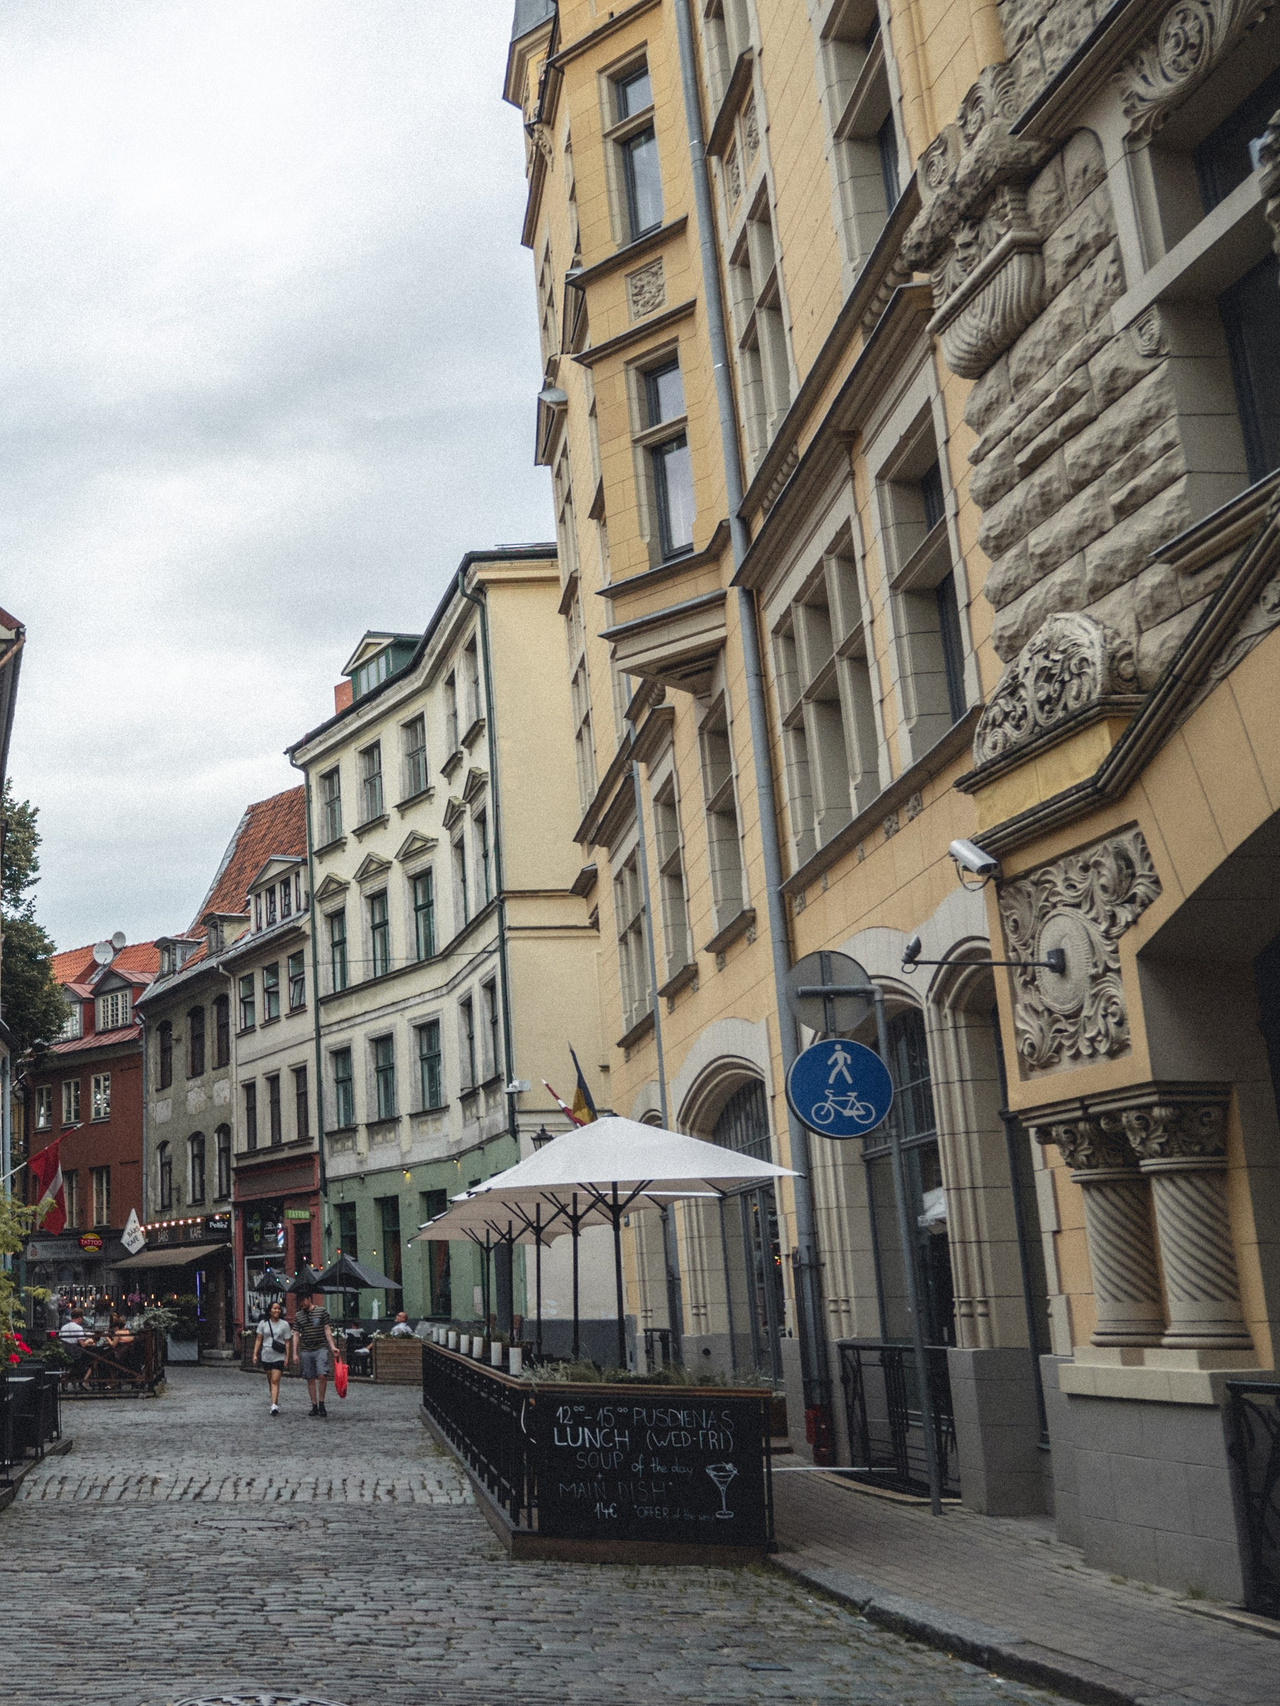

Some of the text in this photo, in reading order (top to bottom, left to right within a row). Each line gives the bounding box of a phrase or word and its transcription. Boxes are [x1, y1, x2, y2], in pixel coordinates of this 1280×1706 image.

[633, 1407, 734, 1431] PUSDIENAS
[554, 1427, 734, 1452] LUNCH (WED-FRI)
[576, 1451, 693, 1478] SOUP of the day
[559, 1482, 606, 1500] MAIN
